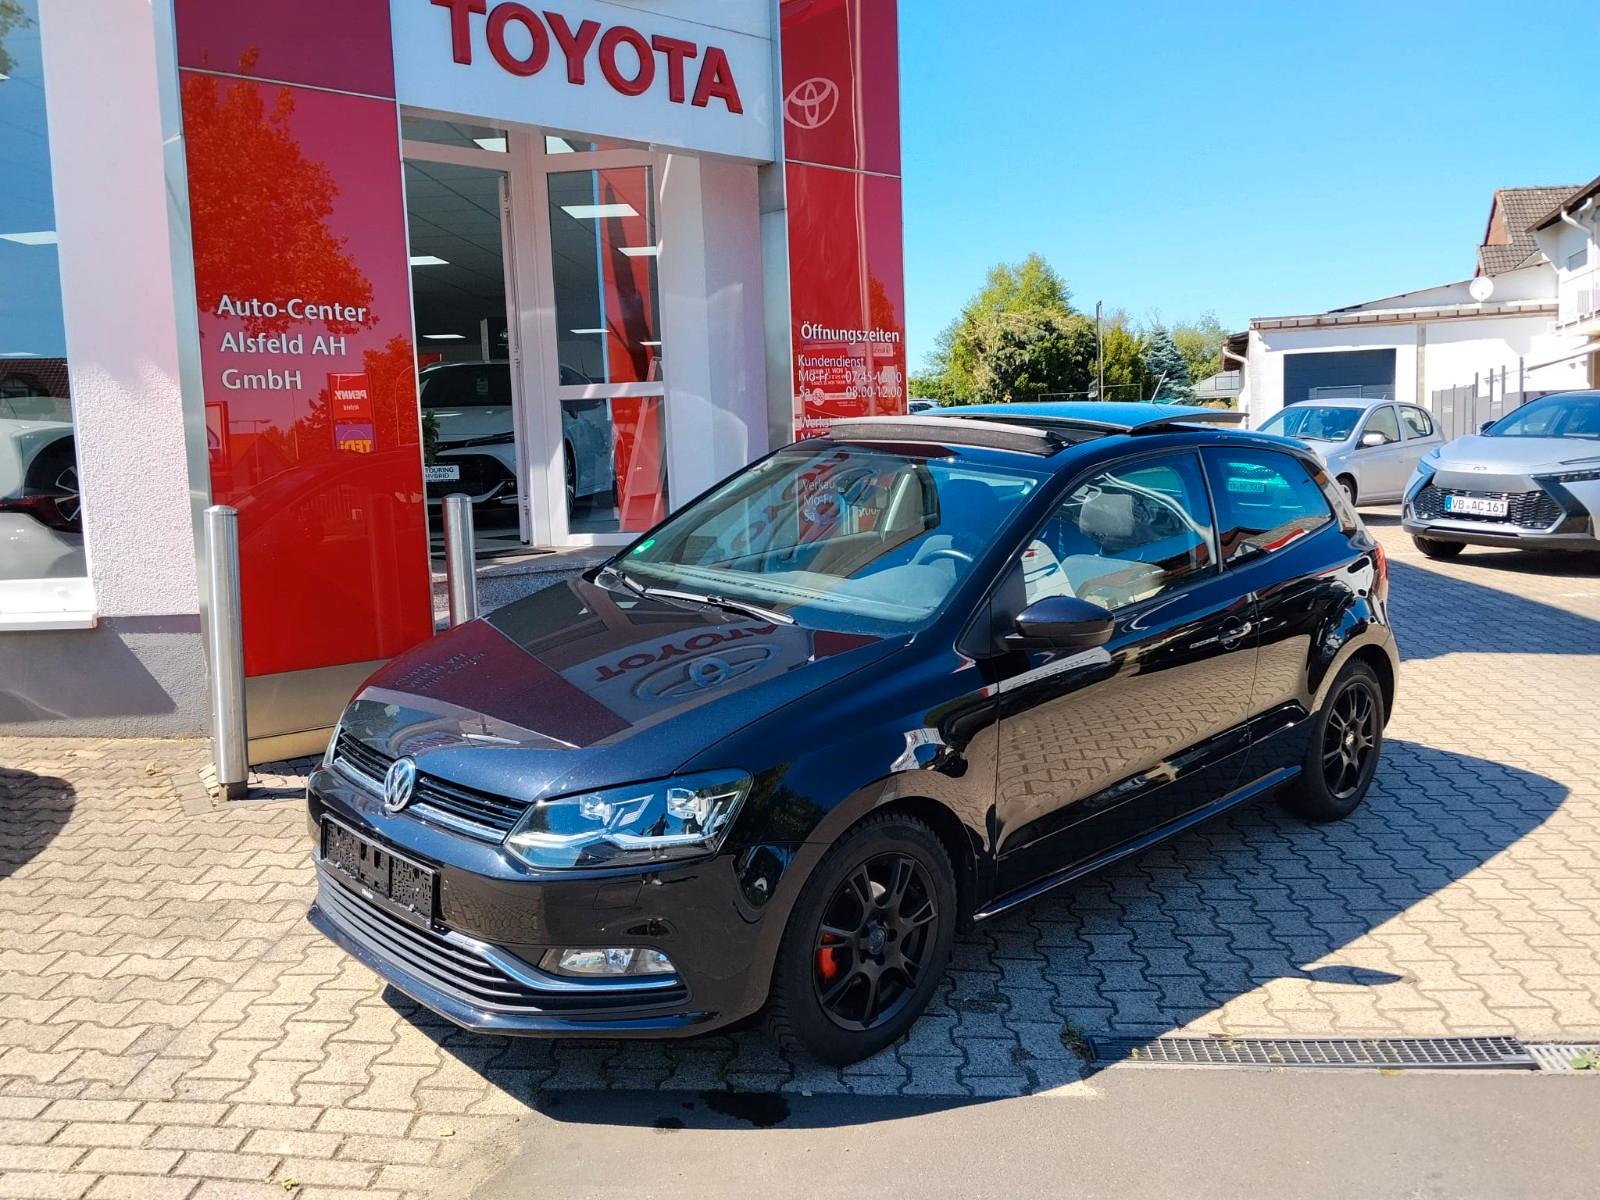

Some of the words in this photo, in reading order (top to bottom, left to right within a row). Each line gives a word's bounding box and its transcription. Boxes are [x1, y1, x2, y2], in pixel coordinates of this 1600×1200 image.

[430, 0, 744, 115] TOYOTA
[217, 294, 367, 322] Auto-Center
[801, 321, 900, 345] Öffnungszeiten
[220, 332, 303, 355] Alsfeld
[312, 335, 346, 356] AH
[798, 354, 865, 368] Kundendienst
[221, 369, 302, 390] GmbH
[799, 370, 828, 382] Mo-Fr
[799, 386, 811, 398] Sa
[1471, 500, 1485, 511] AC
[1485, 501, 1505, 513] 161
